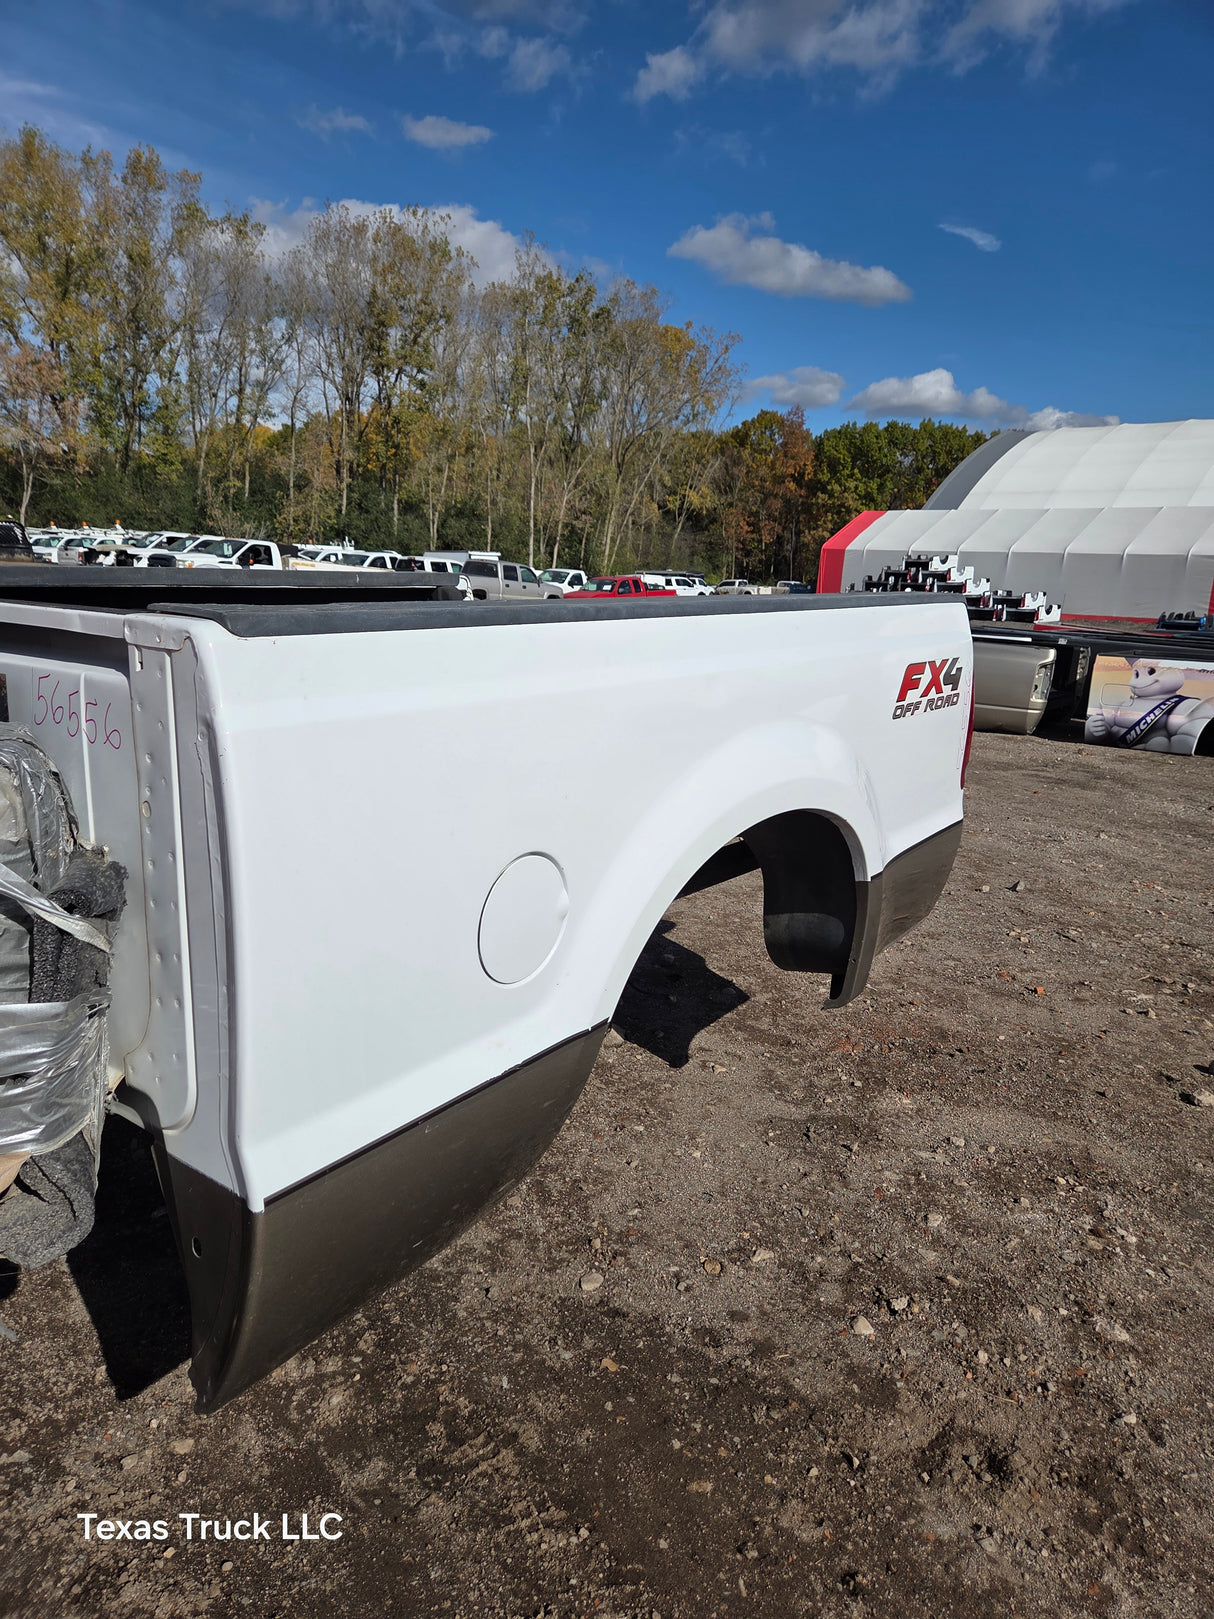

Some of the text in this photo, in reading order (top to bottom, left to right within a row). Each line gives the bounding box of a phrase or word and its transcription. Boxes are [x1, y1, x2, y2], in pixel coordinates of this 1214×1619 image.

[895, 656, 963, 703] FX4
[33, 673, 122, 750] 56556
[892, 692, 960, 720] OFF ROAD
[1125, 697, 1180, 745] MICHELIN
